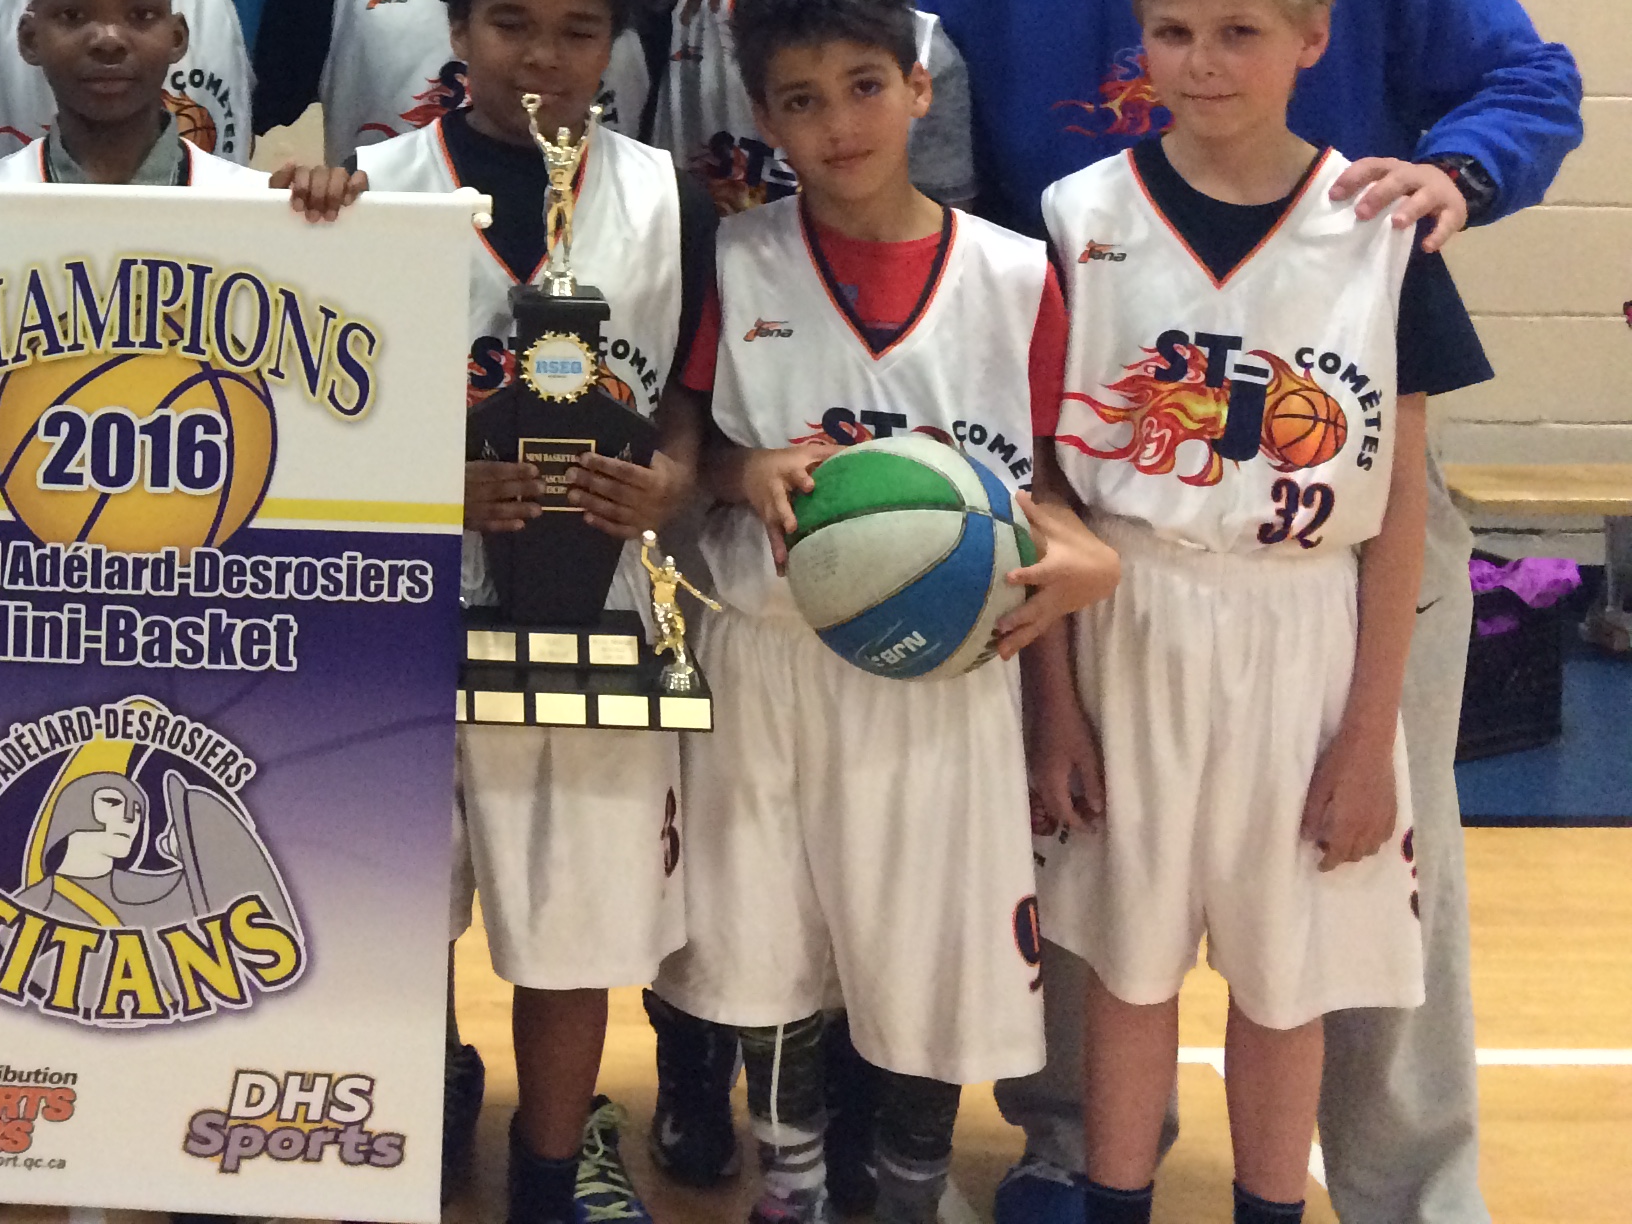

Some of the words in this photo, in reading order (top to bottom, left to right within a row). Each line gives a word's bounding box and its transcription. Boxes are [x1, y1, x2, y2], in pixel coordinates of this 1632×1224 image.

[37, 407, 229, 495] 2016
[1256, 477, 1335, 550] 32
[4, 539, 433, 603] Adélard-Desrosiers
[228, 1068, 376, 1124] DHS
[183, 1109, 407, 1174] Sports
